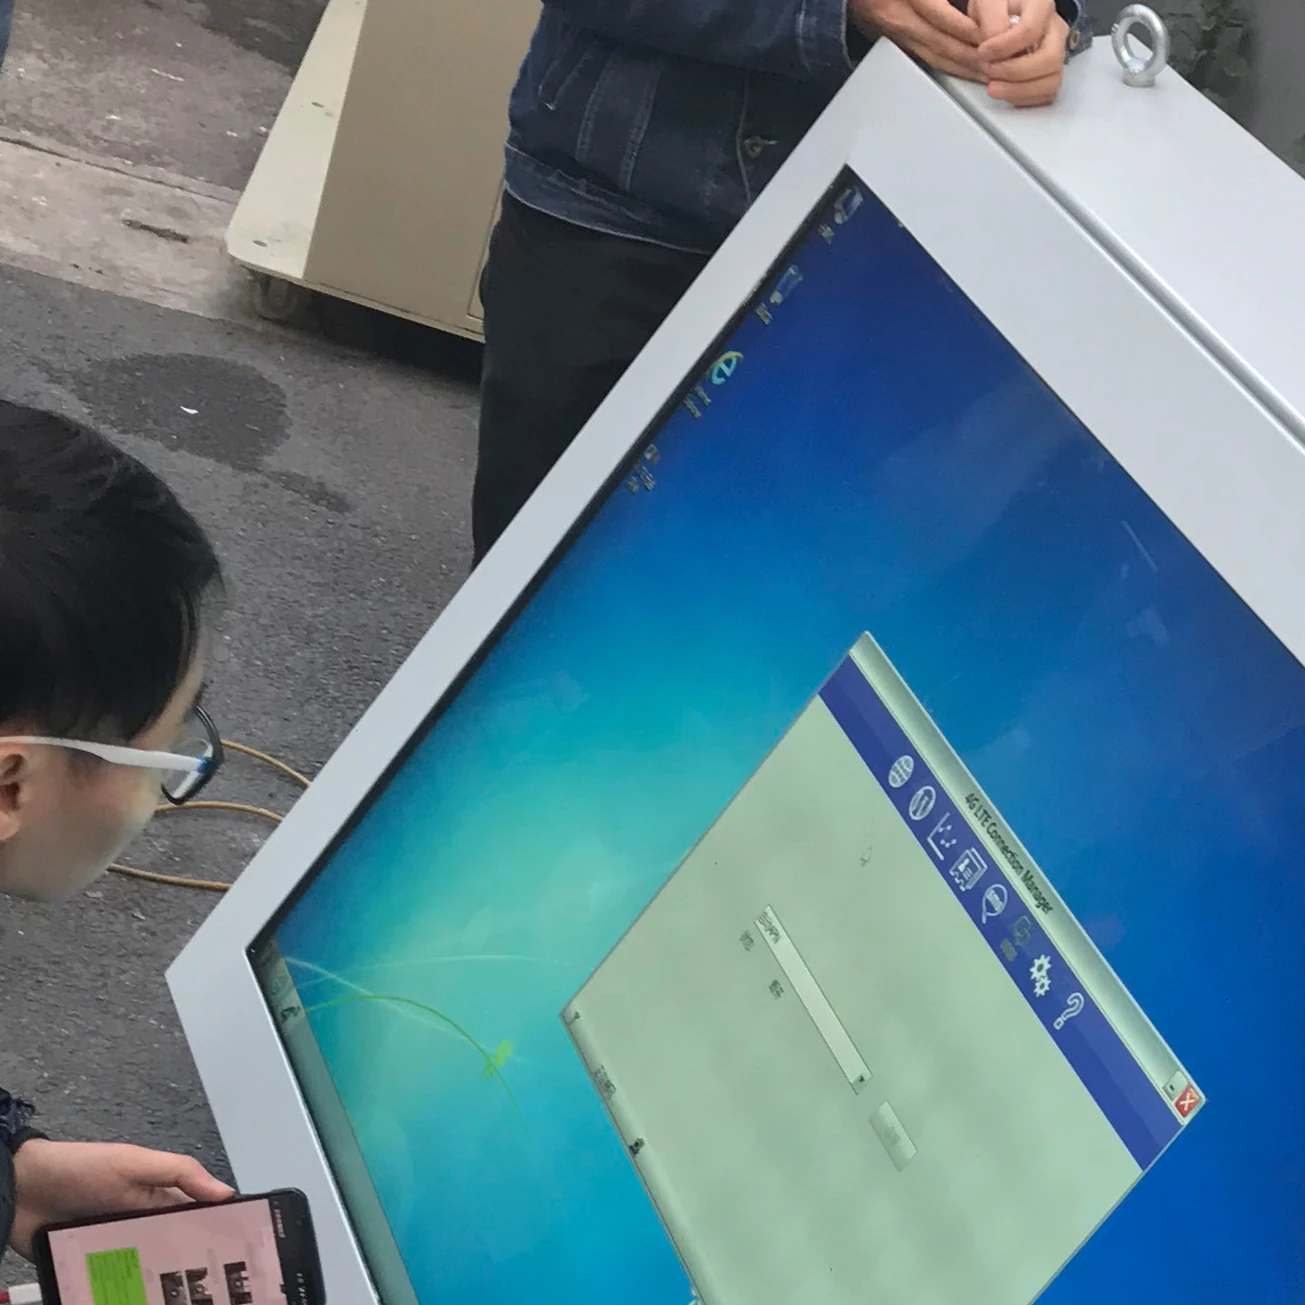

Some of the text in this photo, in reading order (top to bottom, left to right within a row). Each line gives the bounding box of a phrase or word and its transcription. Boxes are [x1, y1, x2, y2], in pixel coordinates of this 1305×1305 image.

[965, 793, 1053, 914] 4G LTE Connection Manager
